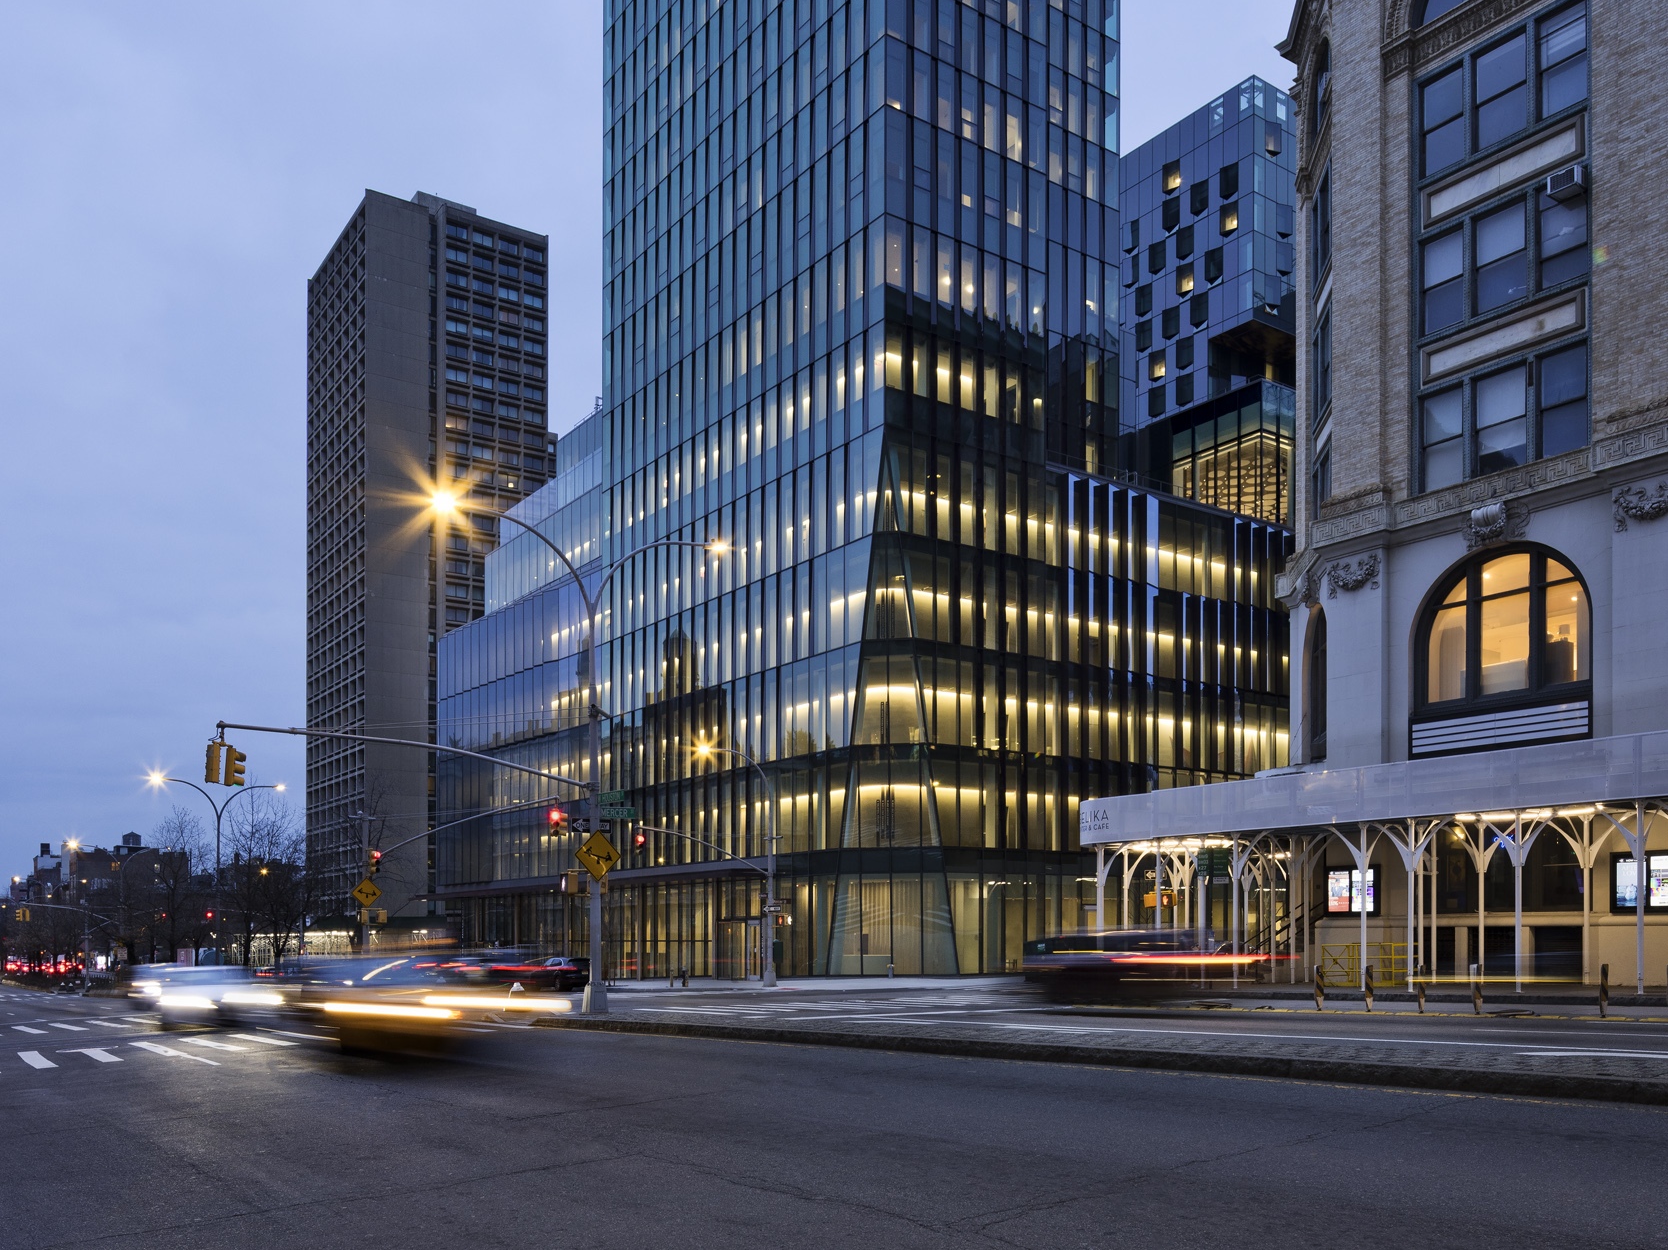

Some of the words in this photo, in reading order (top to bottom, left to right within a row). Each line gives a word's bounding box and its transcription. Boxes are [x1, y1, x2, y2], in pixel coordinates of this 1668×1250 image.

[602, 792, 620, 803] HOUSTON
[601, 808, 628, 817] MERCER
[1093, 822, 1109, 830] CAFE
